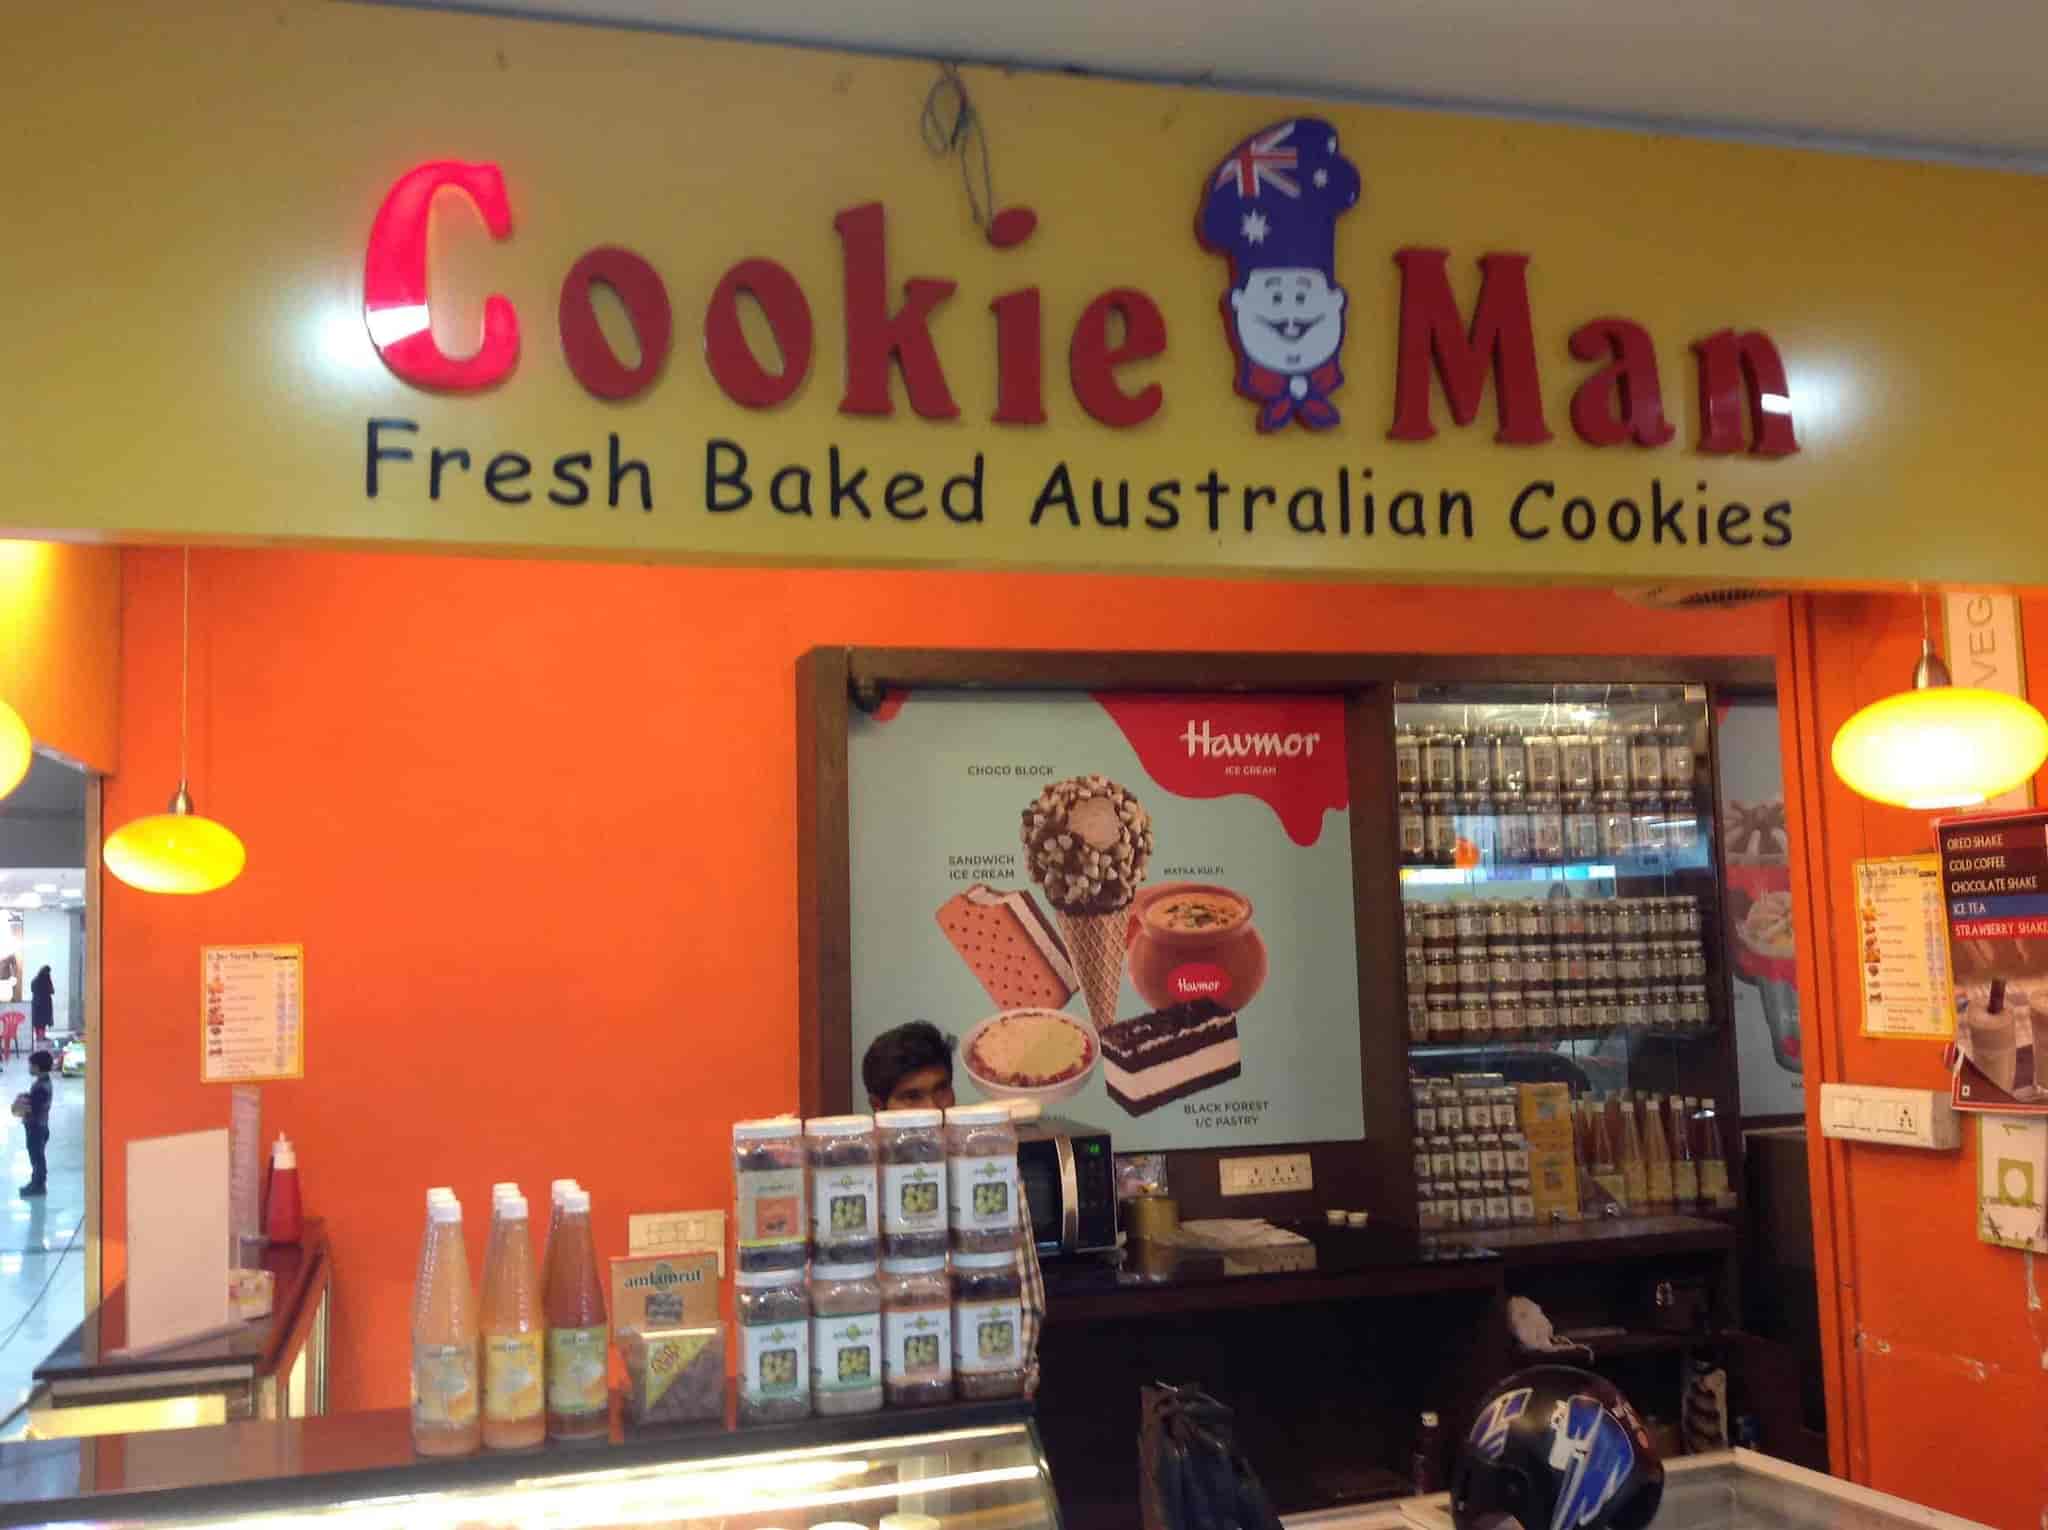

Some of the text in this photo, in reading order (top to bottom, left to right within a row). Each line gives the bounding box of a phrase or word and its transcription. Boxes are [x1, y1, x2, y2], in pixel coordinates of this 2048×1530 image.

[362, 158, 1803, 460] Cookie Man
[366, 418, 1793, 547] Fresh Baked Australian Cookies
[1180, 719, 1320, 758] Havmor
[967, 764, 1054, 776] CHOCO BLOCK
[1225, 766, 1277, 776] ICE CREAM
[1972, 833, 2004, 848] SHAKE
[948, 854, 1015, 865] SANDWICH
[1949, 856, 2007, 872] COLD COFFEE
[950, 868, 1015, 880] ICE CREAM
[1951, 875, 2039, 893] CHOCOLATE SHAKE
[1952, 902, 1987, 914] ICE TEA
[1955, 922, 2015, 937] STRAWBERRY
[1177, 977, 1220, 993] Havmor
[1183, 1101, 1269, 1114] BLACK FOREST
[1215, 1115, 1257, 1128] PASTRY
